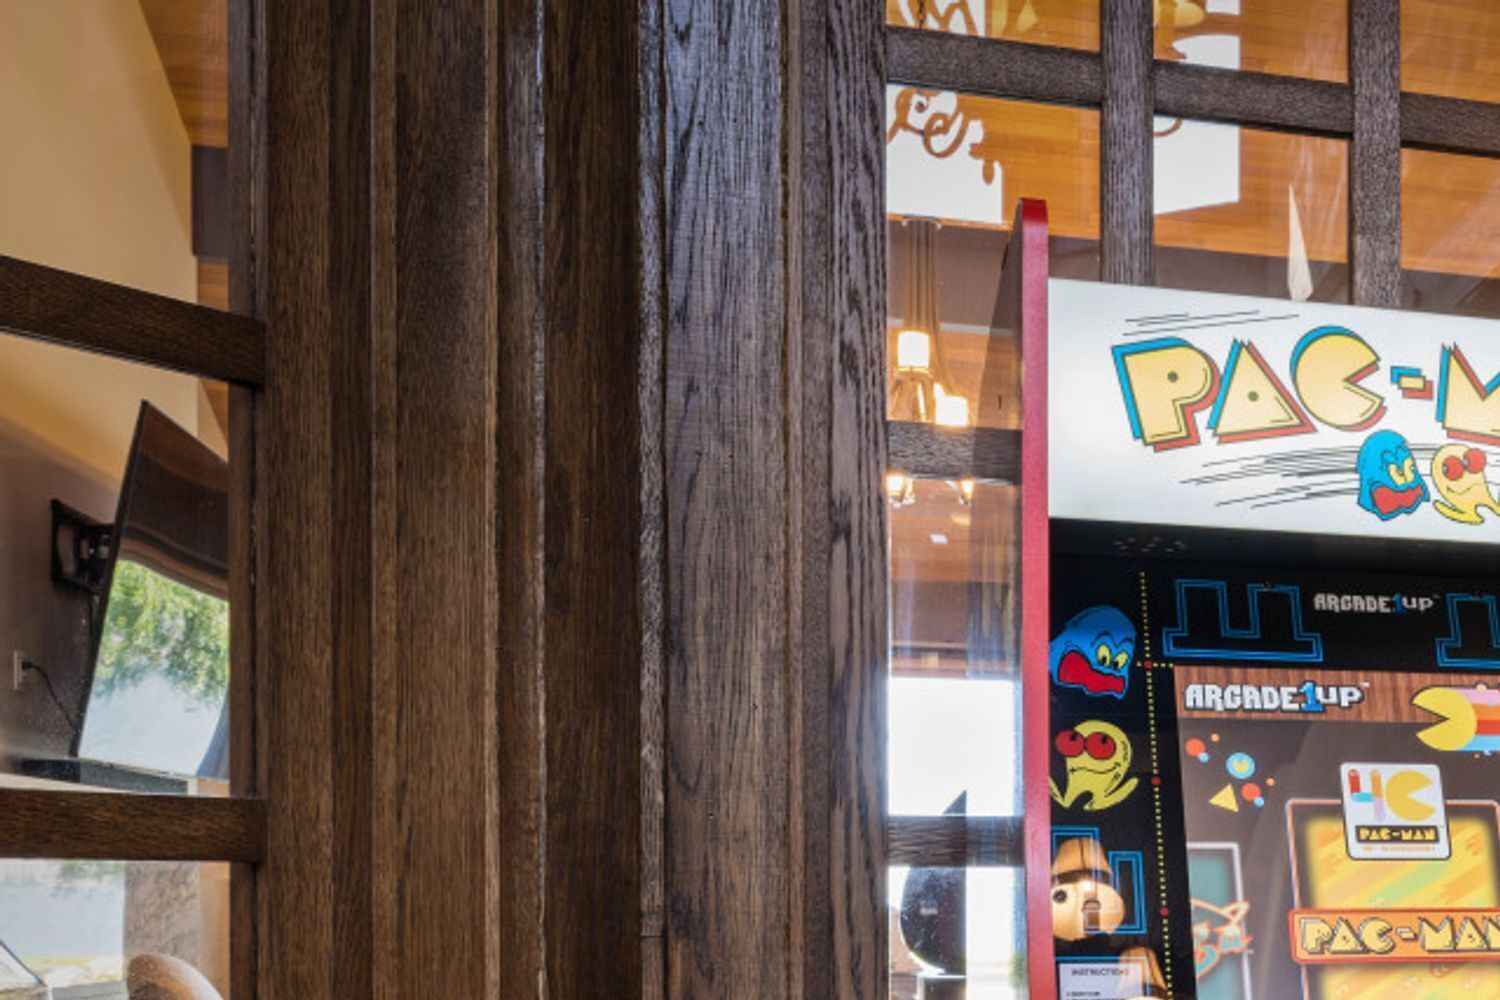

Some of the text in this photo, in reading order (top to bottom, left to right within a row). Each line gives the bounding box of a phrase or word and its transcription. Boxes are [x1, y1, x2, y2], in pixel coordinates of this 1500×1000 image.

[1313, 592, 1435, 614] ARCADE1UP
[1185, 681, 1364, 712] ARCADE1UP
[1358, 826, 1437, 842] PAC-MAN
